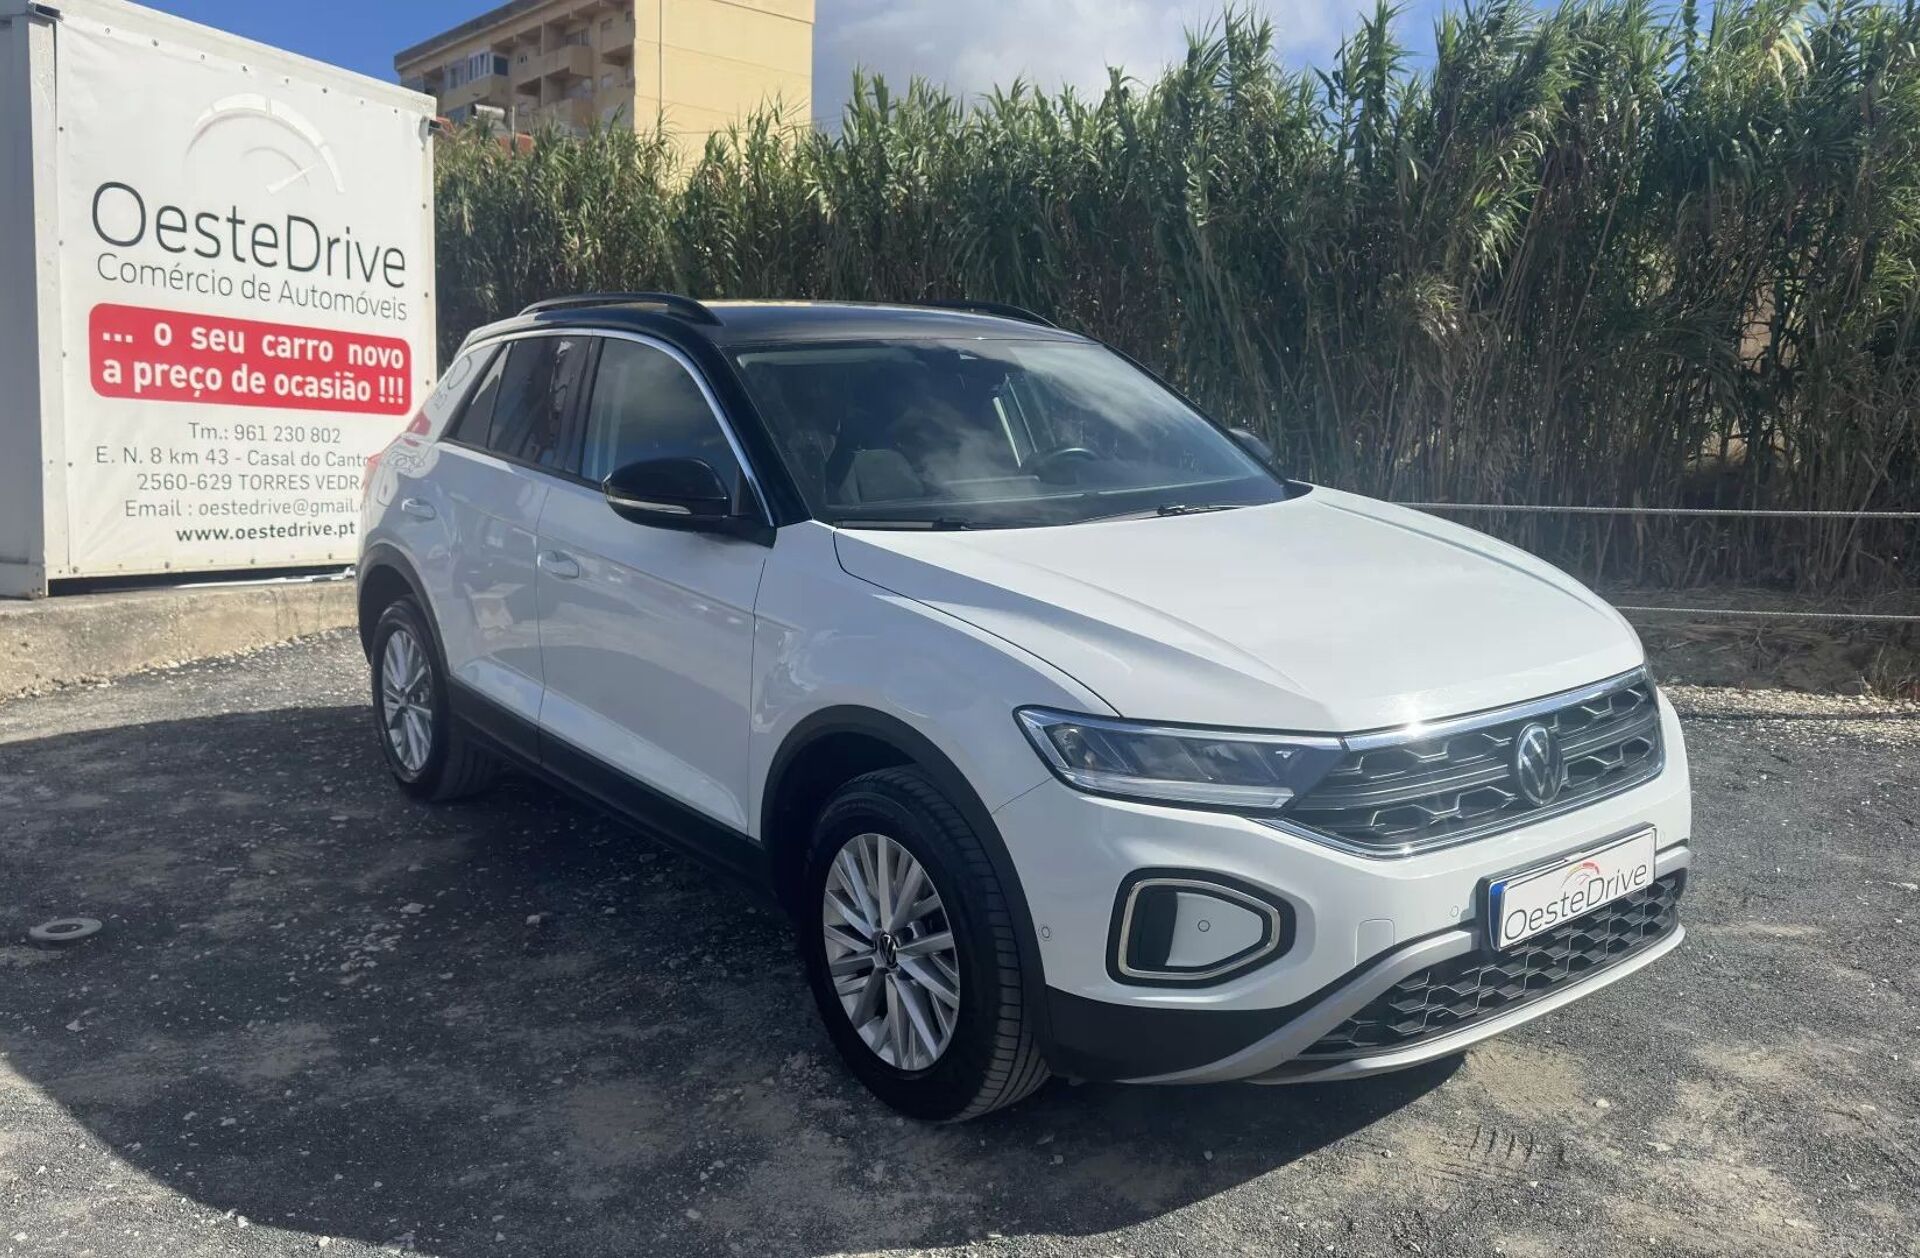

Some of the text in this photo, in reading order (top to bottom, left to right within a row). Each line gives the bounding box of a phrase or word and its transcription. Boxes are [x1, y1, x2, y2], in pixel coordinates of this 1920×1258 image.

[91, 181, 407, 289] OesteDrive
[97, 252, 407, 321] Comércio de Automóveis
[153, 323, 173, 347] o
[190, 327, 246, 354] seu
[261, 334, 334, 363] carro
[348, 342, 404, 370] novo
[102, 359, 404, 405] a preço de ocasião !!!
[188, 422, 341, 444] Tm.: 961 230 802
[96, 446, 115, 464] E.
[123, 447, 143, 464] N.
[150, 447, 162, 464] 8
[169, 448, 199, 465] km
[205, 449, 229, 466] 43
[247, 450, 295, 467] Casal
[300, 451, 321, 467] do
[136, 473, 365, 491] 2560-629 TORRES VEDR
[124, 499, 182, 517] Email
[198, 499, 363, 517] oestedrive@gmail.
[176, 521, 356, 542] www.oestedrive.pt
[1505, 864, 1647, 941] OesteDrive
